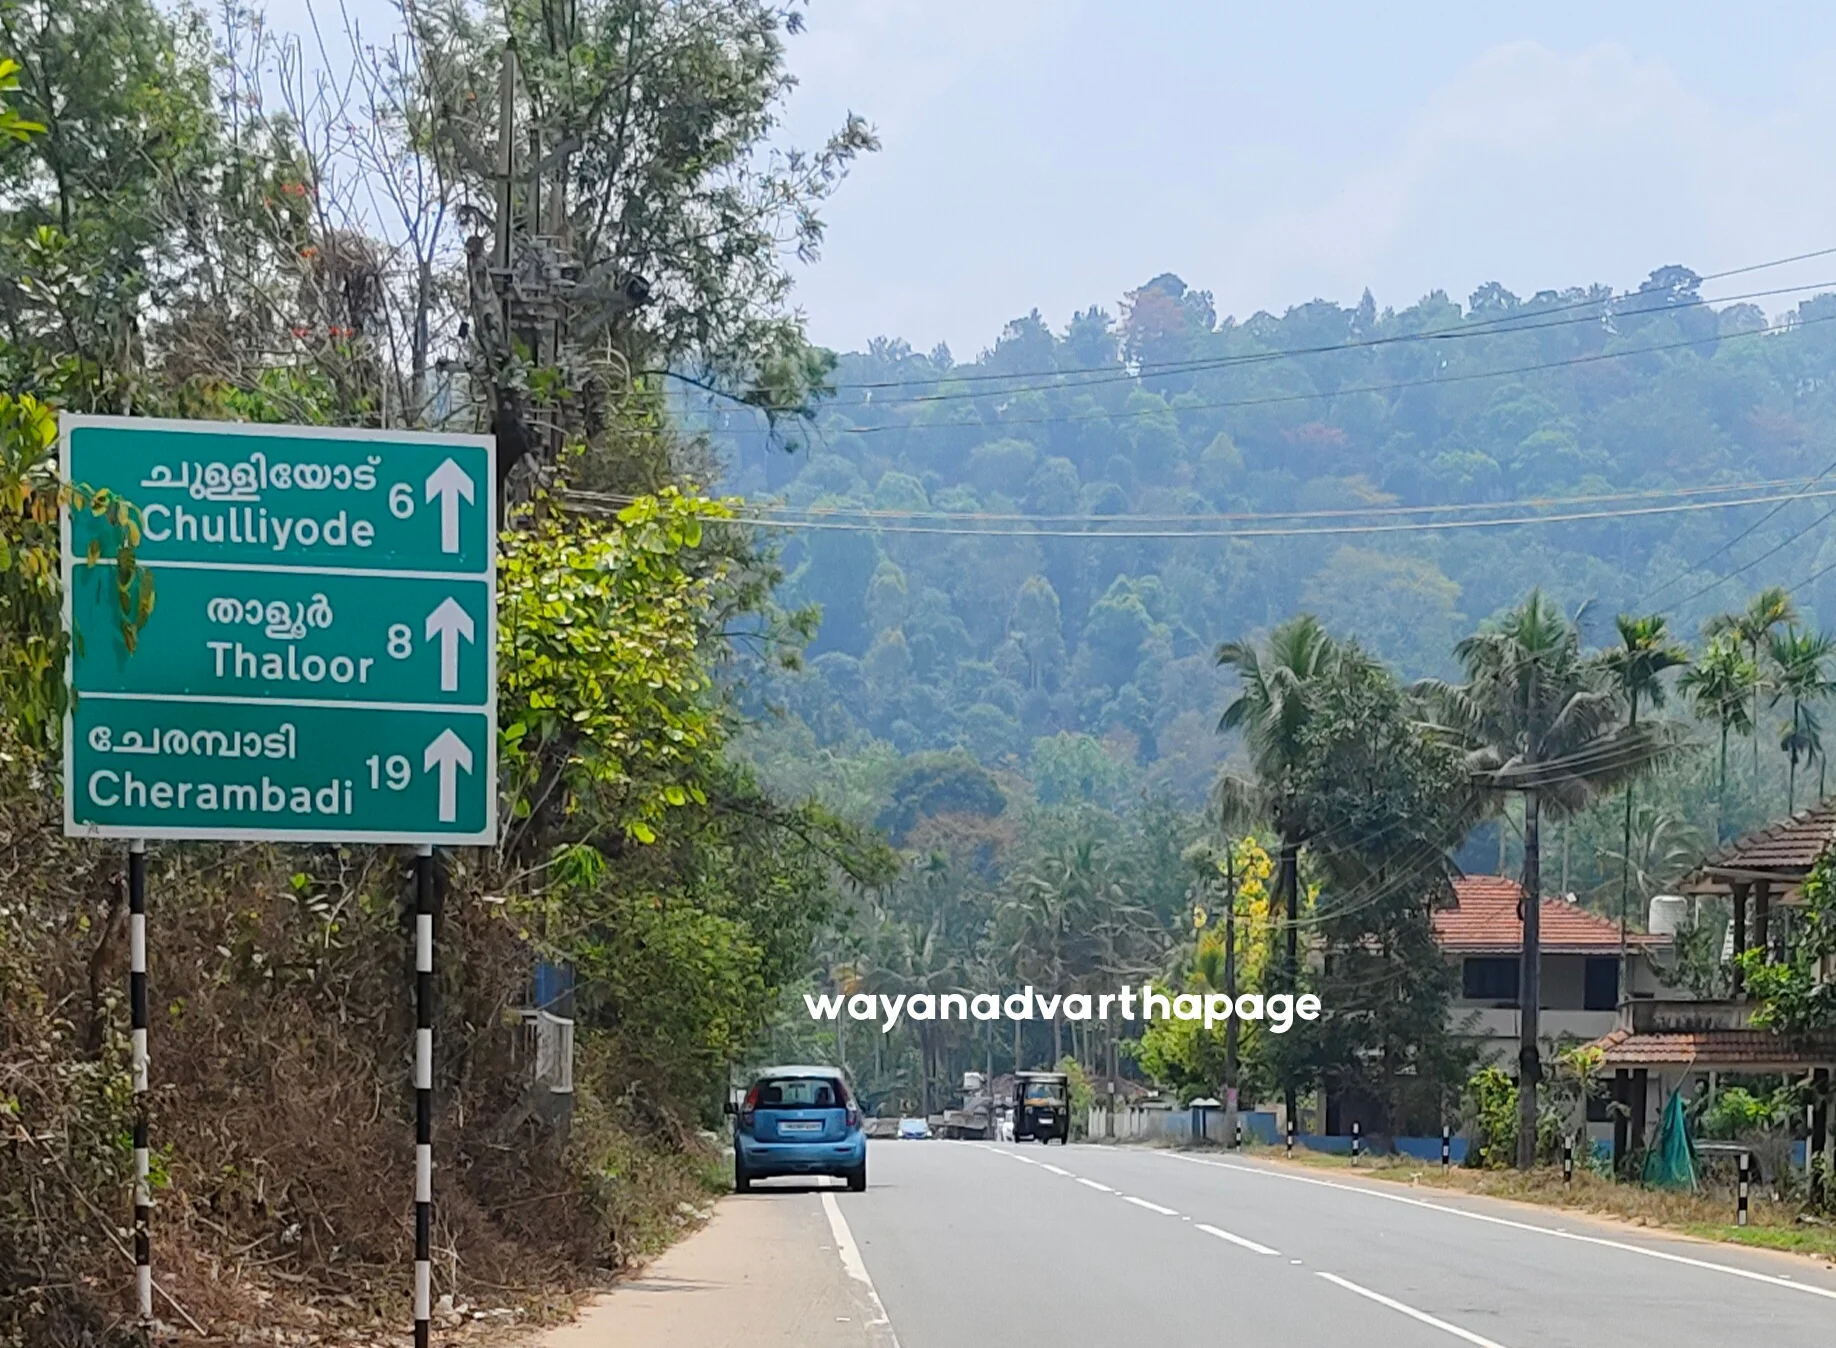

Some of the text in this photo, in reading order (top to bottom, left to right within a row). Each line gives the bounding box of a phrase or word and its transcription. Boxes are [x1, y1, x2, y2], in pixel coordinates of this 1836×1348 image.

[140, 452, 381, 502] ചുള്ളിയോട്
[389, 483, 414, 519] 6
[141, 503, 375, 551] Chulliyode
[207, 593, 333, 640] താളൂർ
[206, 641, 374, 683] Thaloor
[387, 623, 412, 659] 8
[88, 723, 297, 759] ചേരമ്പാടി
[88, 770, 353, 814] Cherambadi
[366, 754, 411, 790] 19
